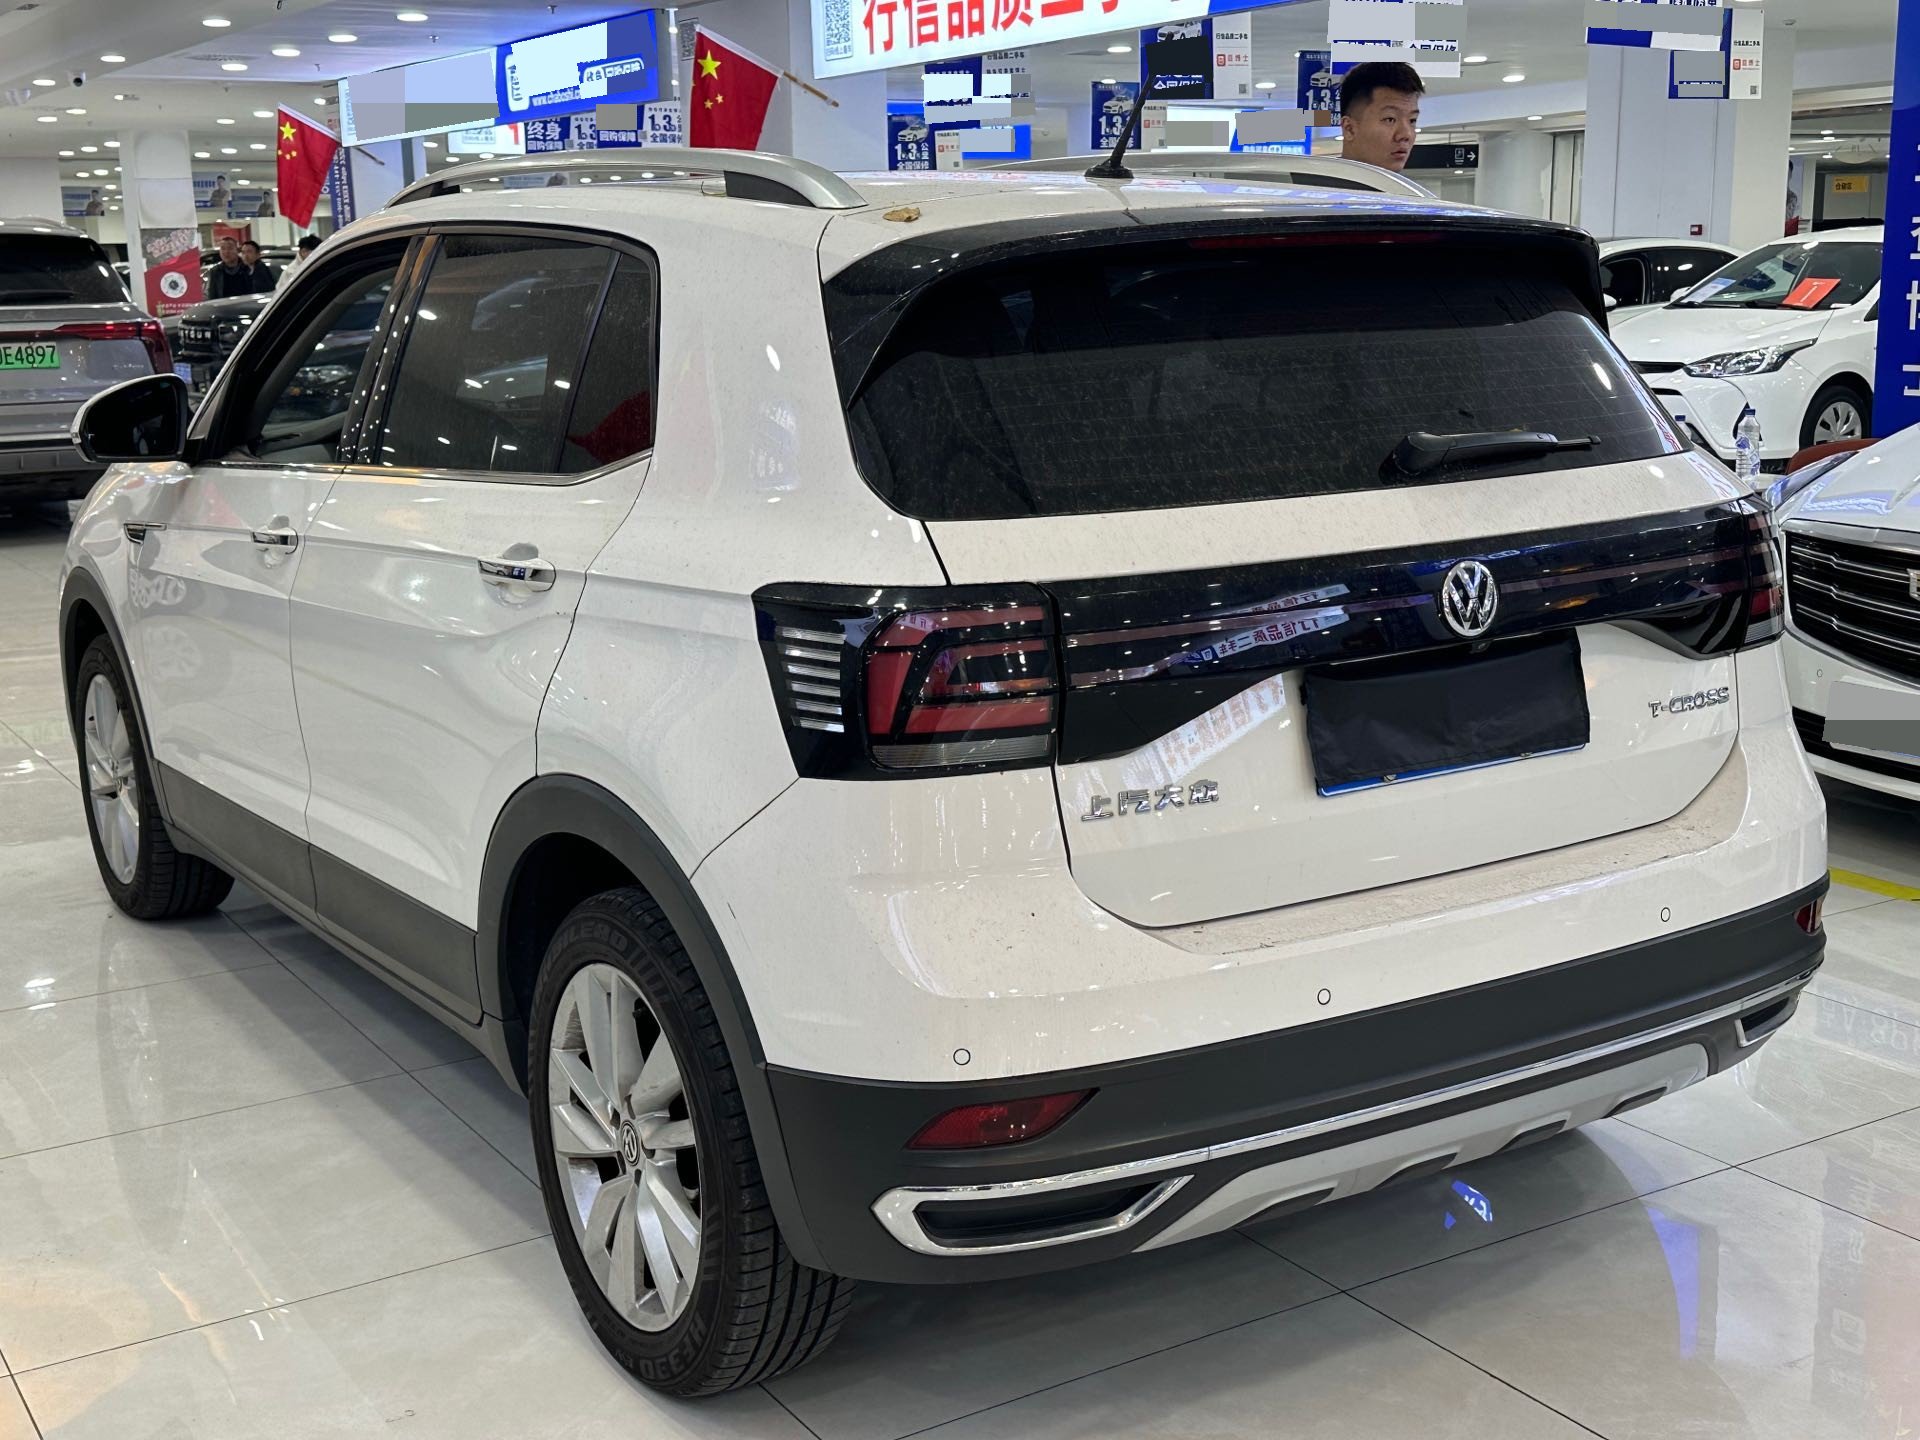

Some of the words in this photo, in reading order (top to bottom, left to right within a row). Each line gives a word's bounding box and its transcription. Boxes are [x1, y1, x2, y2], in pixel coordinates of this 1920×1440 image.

[1647, 686, 1730, 718] T-CROSS
[1080, 779, 1220, 822] 上汽大众
